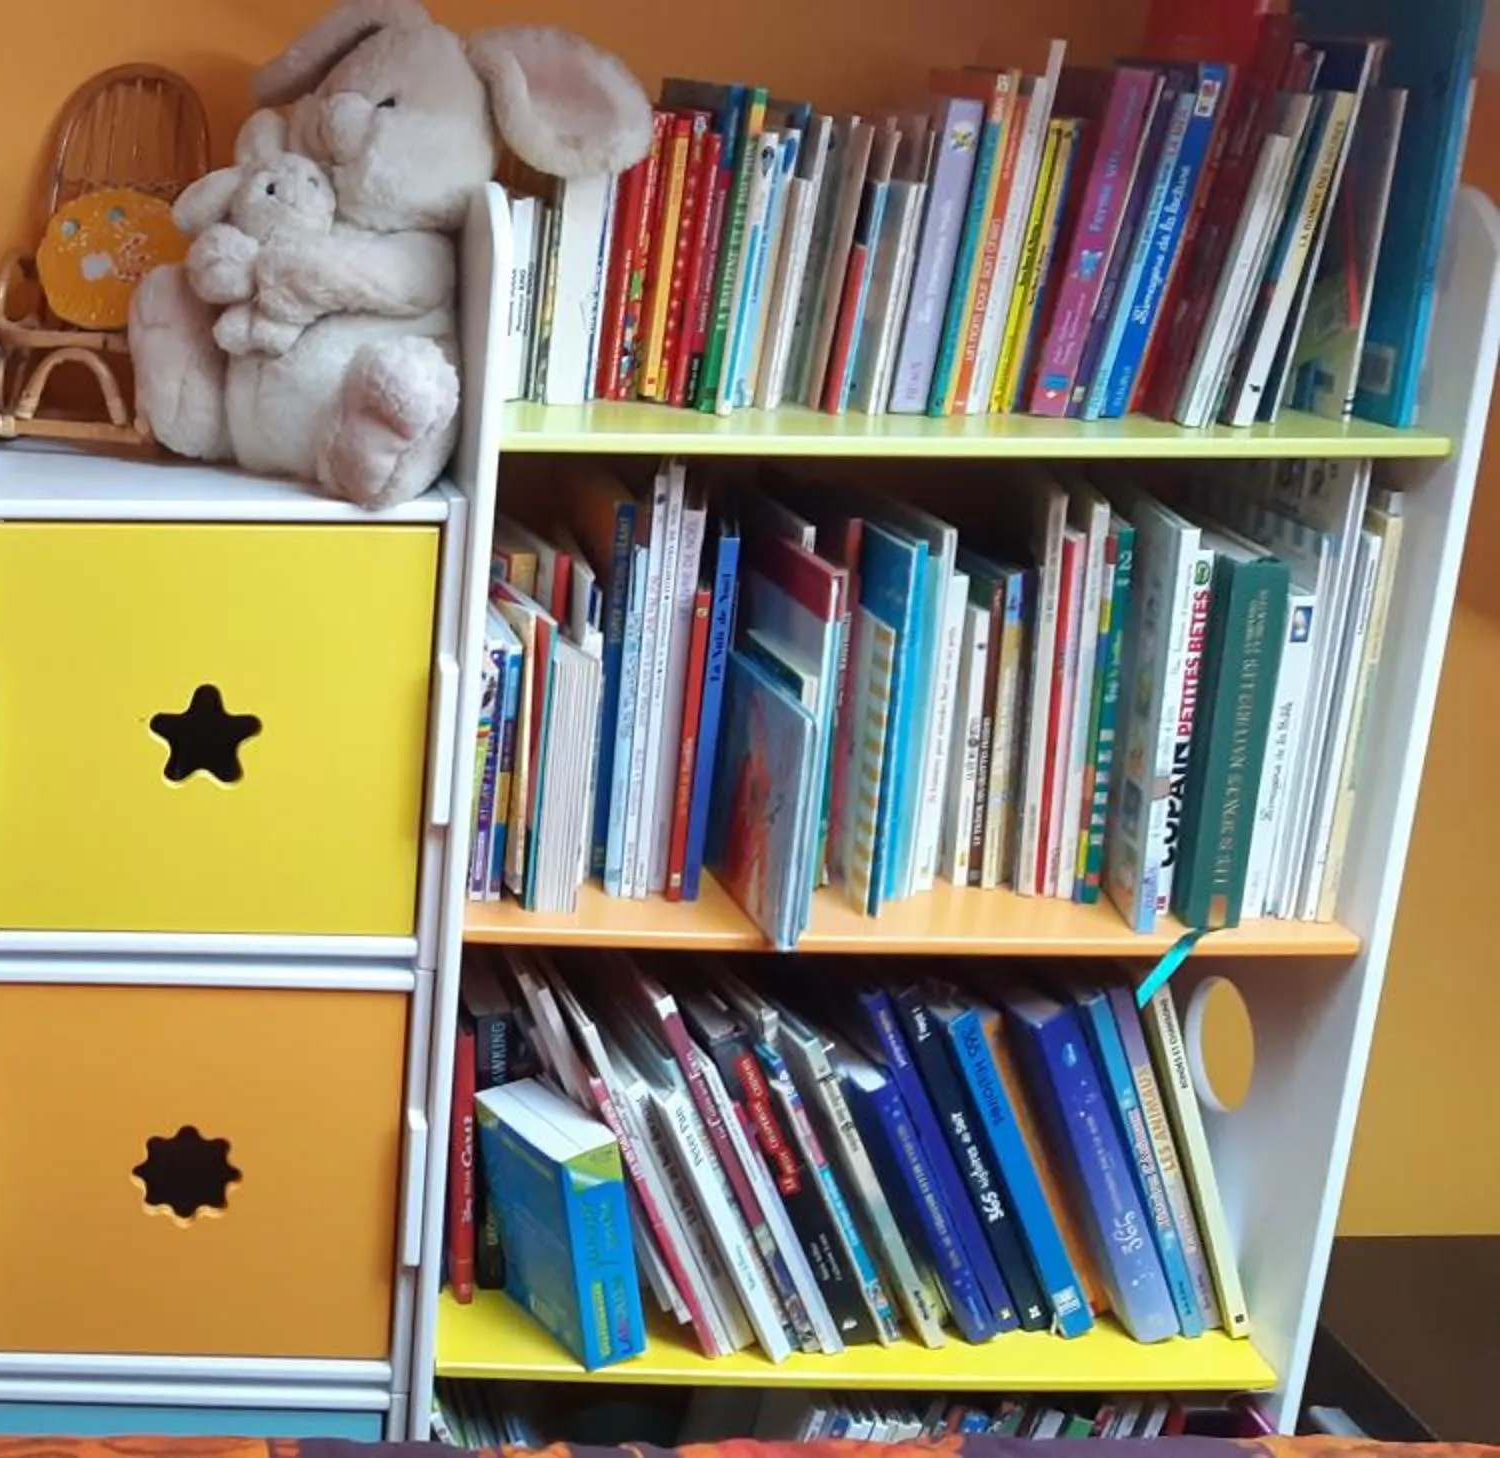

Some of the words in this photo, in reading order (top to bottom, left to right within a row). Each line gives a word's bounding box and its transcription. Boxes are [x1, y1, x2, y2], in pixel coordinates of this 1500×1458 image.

[1164, 162, 1192, 214] lecture
[1153, 231, 1171, 252] de
[1158, 213, 1176, 231] la
[708, 662, 721, 681] La
[715, 609, 727, 625] de
[1174, 656, 1202, 737] PETITES
[486, 1022, 509, 1081] AWKING
[959, 1026, 985, 1058] 365
[967, 1058, 1008, 1127] Histoires
[1133, 1065, 1169, 1143] ANIMAUX
[670, 1106, 692, 1133] Pan
[681, 1132, 706, 1167] Peter
[959, 1143, 994, 1191] histoires
[1155, 1144, 1177, 1174] LES
[977, 1189, 1006, 1223] 365
[1111, 1209, 1144, 1255] 365
